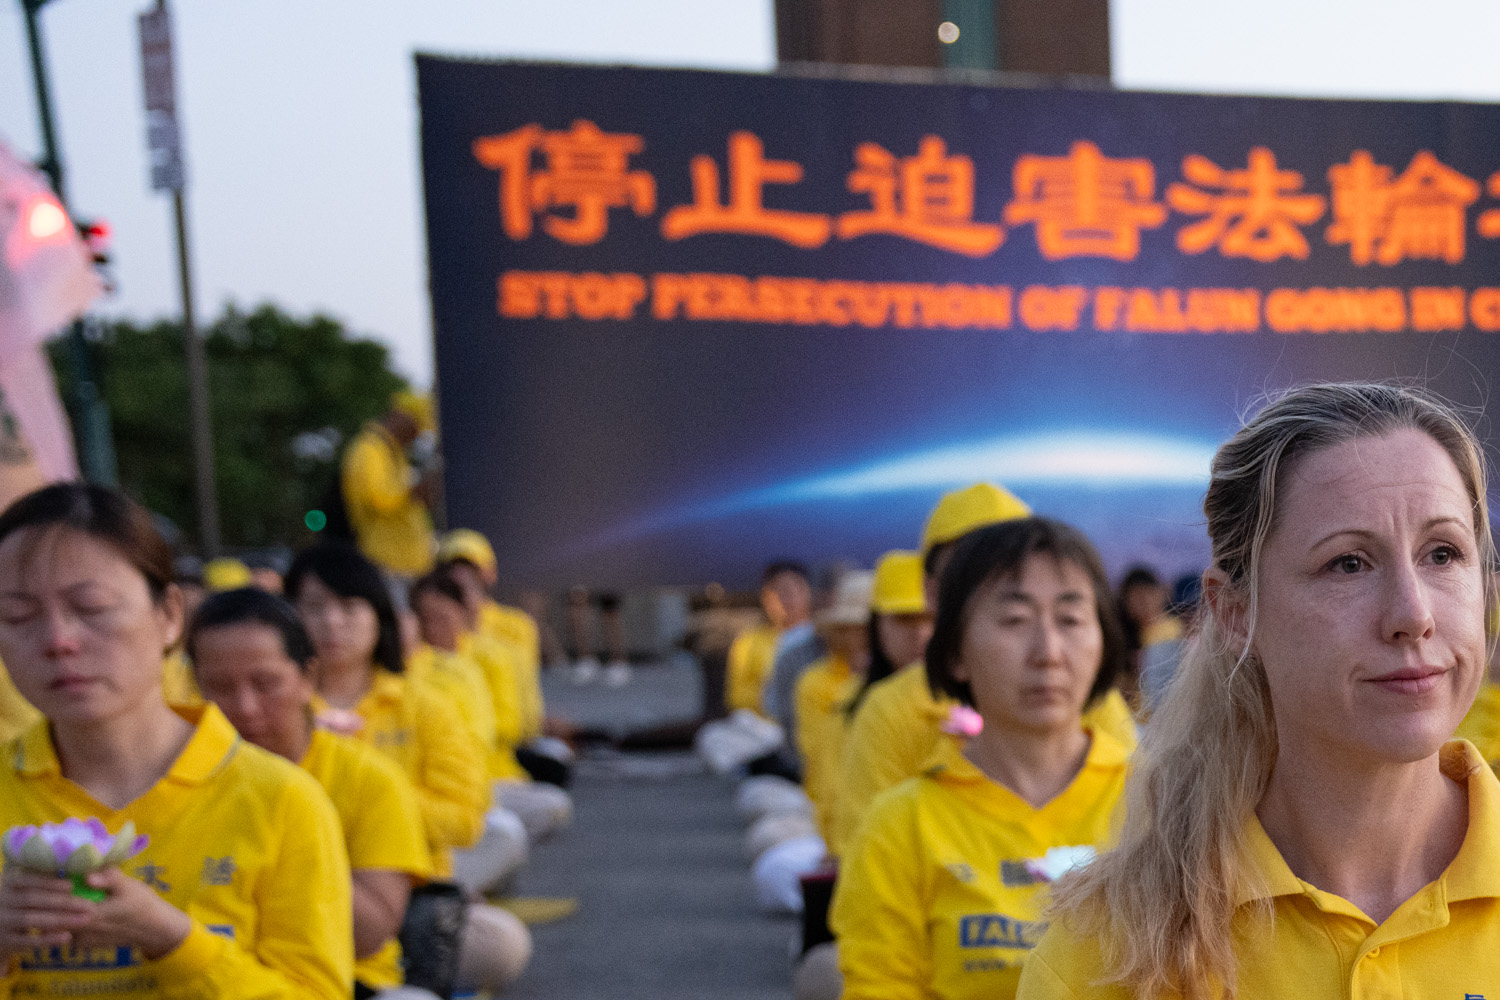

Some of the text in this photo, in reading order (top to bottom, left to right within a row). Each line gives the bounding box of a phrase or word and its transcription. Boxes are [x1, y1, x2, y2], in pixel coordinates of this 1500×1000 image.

[499, 270, 647, 320] STOP
[652, 272, 1014, 329] PERSECUTION
[1017, 285, 1088, 331] OF
[1092, 286, 1261, 333] FALUN
[1263, 286, 1406, 333] GONG
[1408, 286, 1466, 332] IN
